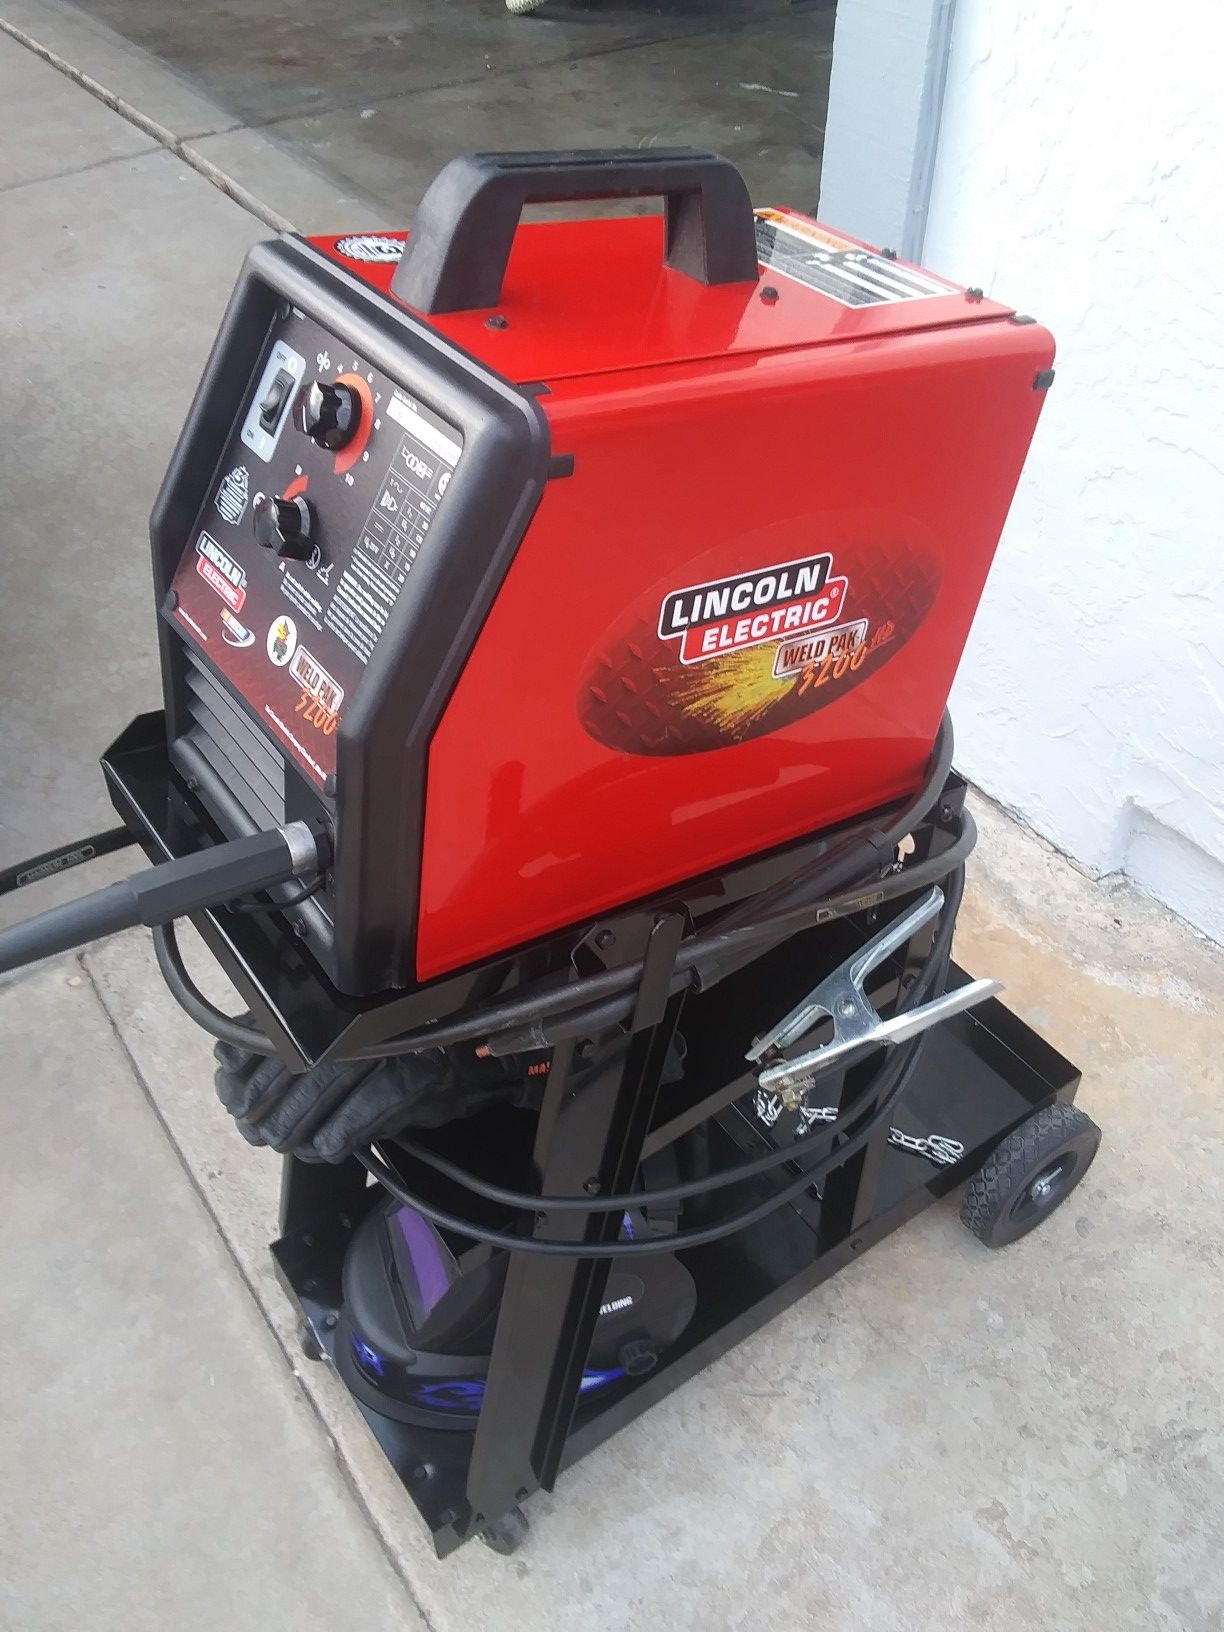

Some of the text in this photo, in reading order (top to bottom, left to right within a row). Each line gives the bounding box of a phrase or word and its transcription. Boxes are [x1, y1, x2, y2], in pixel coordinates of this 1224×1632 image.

[374, 418, 381, 430] 8
[362, 451, 370, 462] 9
[200, 536, 243, 588] LINCOLN
[202, 562, 240, 606] ELECTRIC
[671, 563, 820, 628] LINCOLN
[702, 597, 830, 653] ELECTRIC
[783, 629, 859, 667] WELD PAK
[296, 656, 318, 691] WELD
[317, 681, 338, 711] PAK
[798, 640, 868, 696] 3200
[295, 688, 339, 736] 3200
